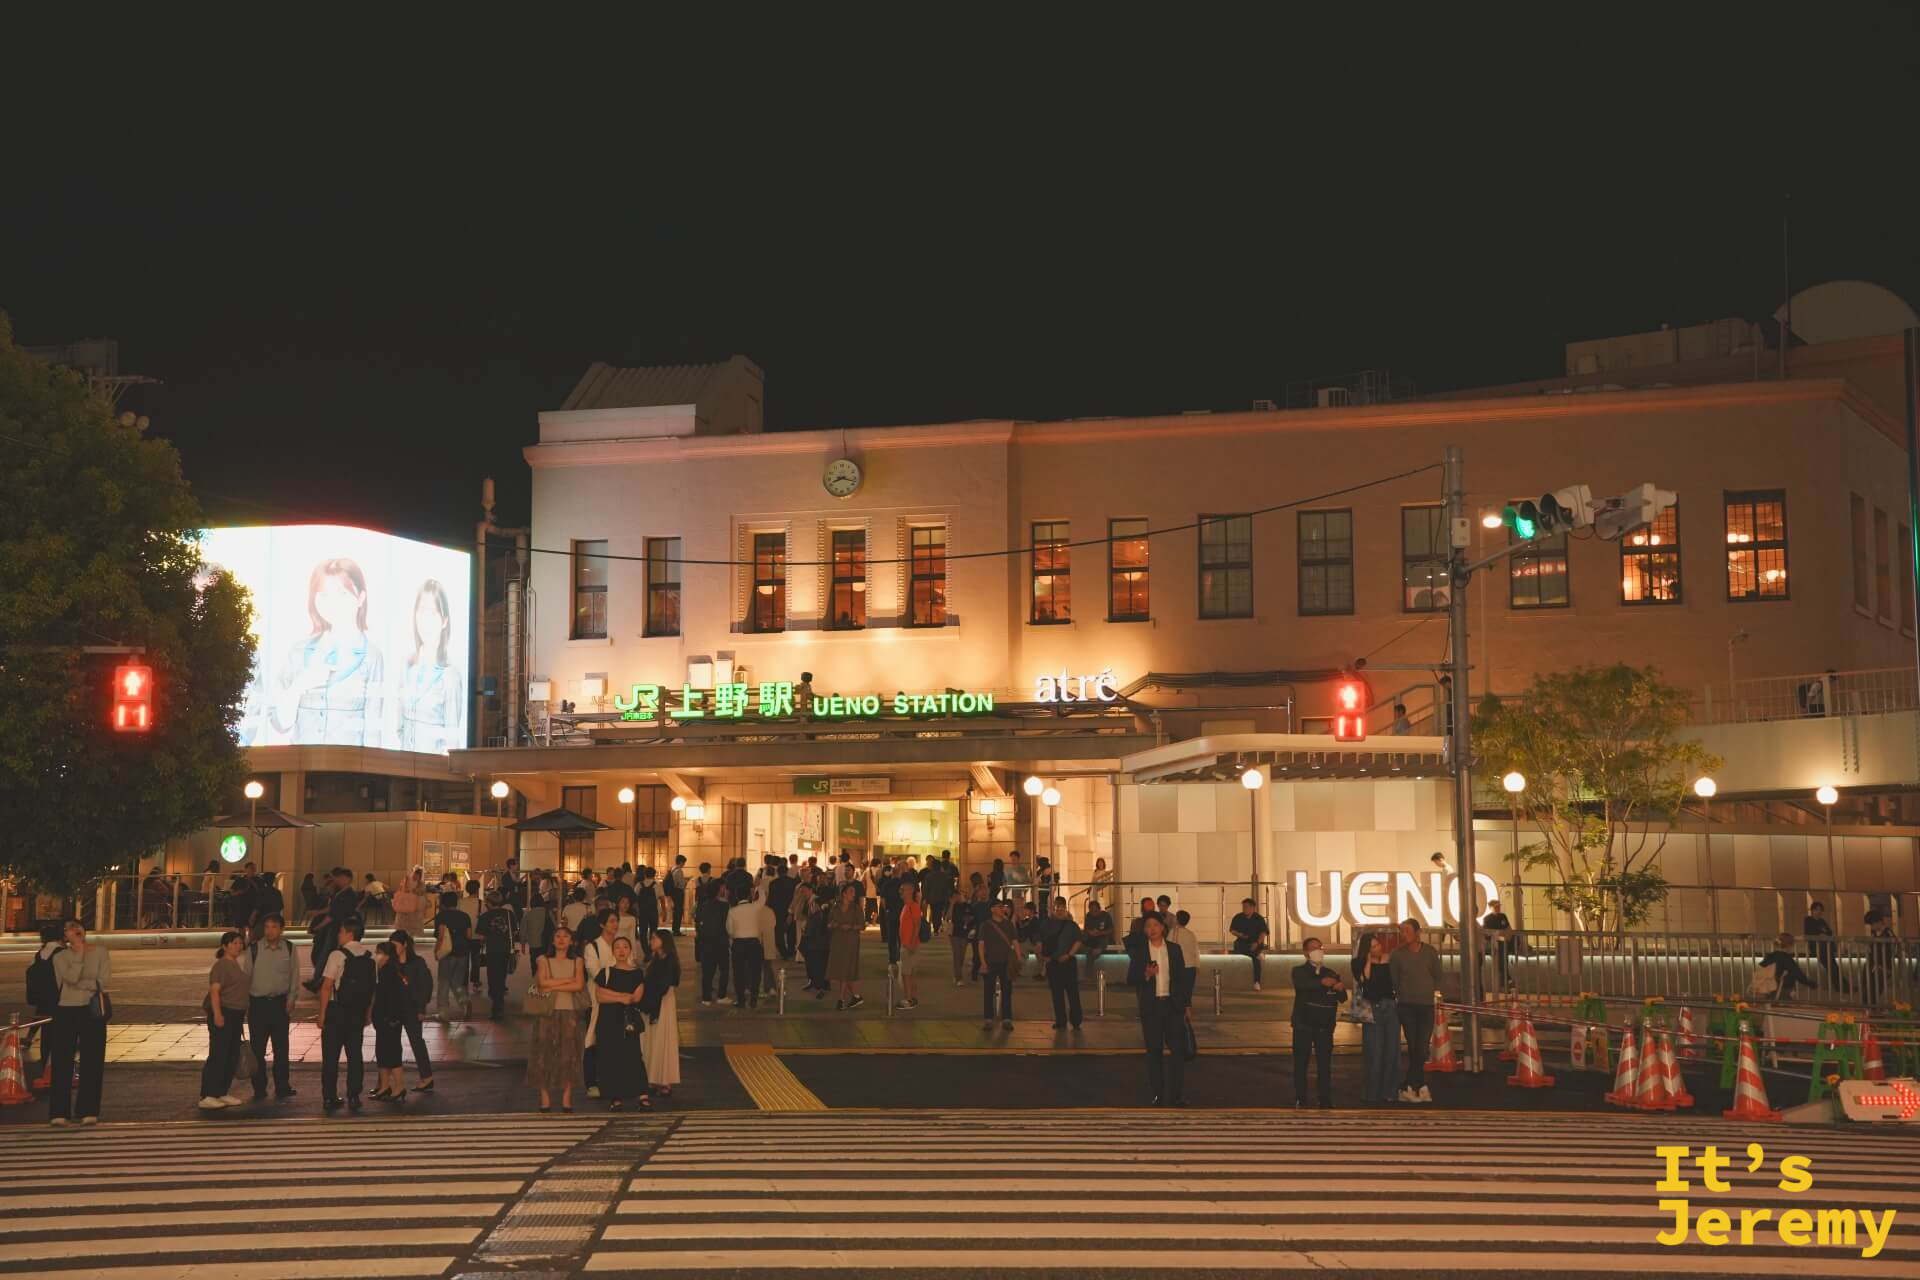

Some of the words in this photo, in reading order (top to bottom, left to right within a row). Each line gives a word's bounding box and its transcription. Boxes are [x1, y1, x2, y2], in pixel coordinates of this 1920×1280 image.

[614, 684, 660, 711] JR
[670, 681, 794, 718] 上野駅
[813, 696, 880, 717] UENO
[894, 693, 994, 715] STATION
[1034, 667, 1118, 703] atré
[1293, 871, 1500, 928] UENO
